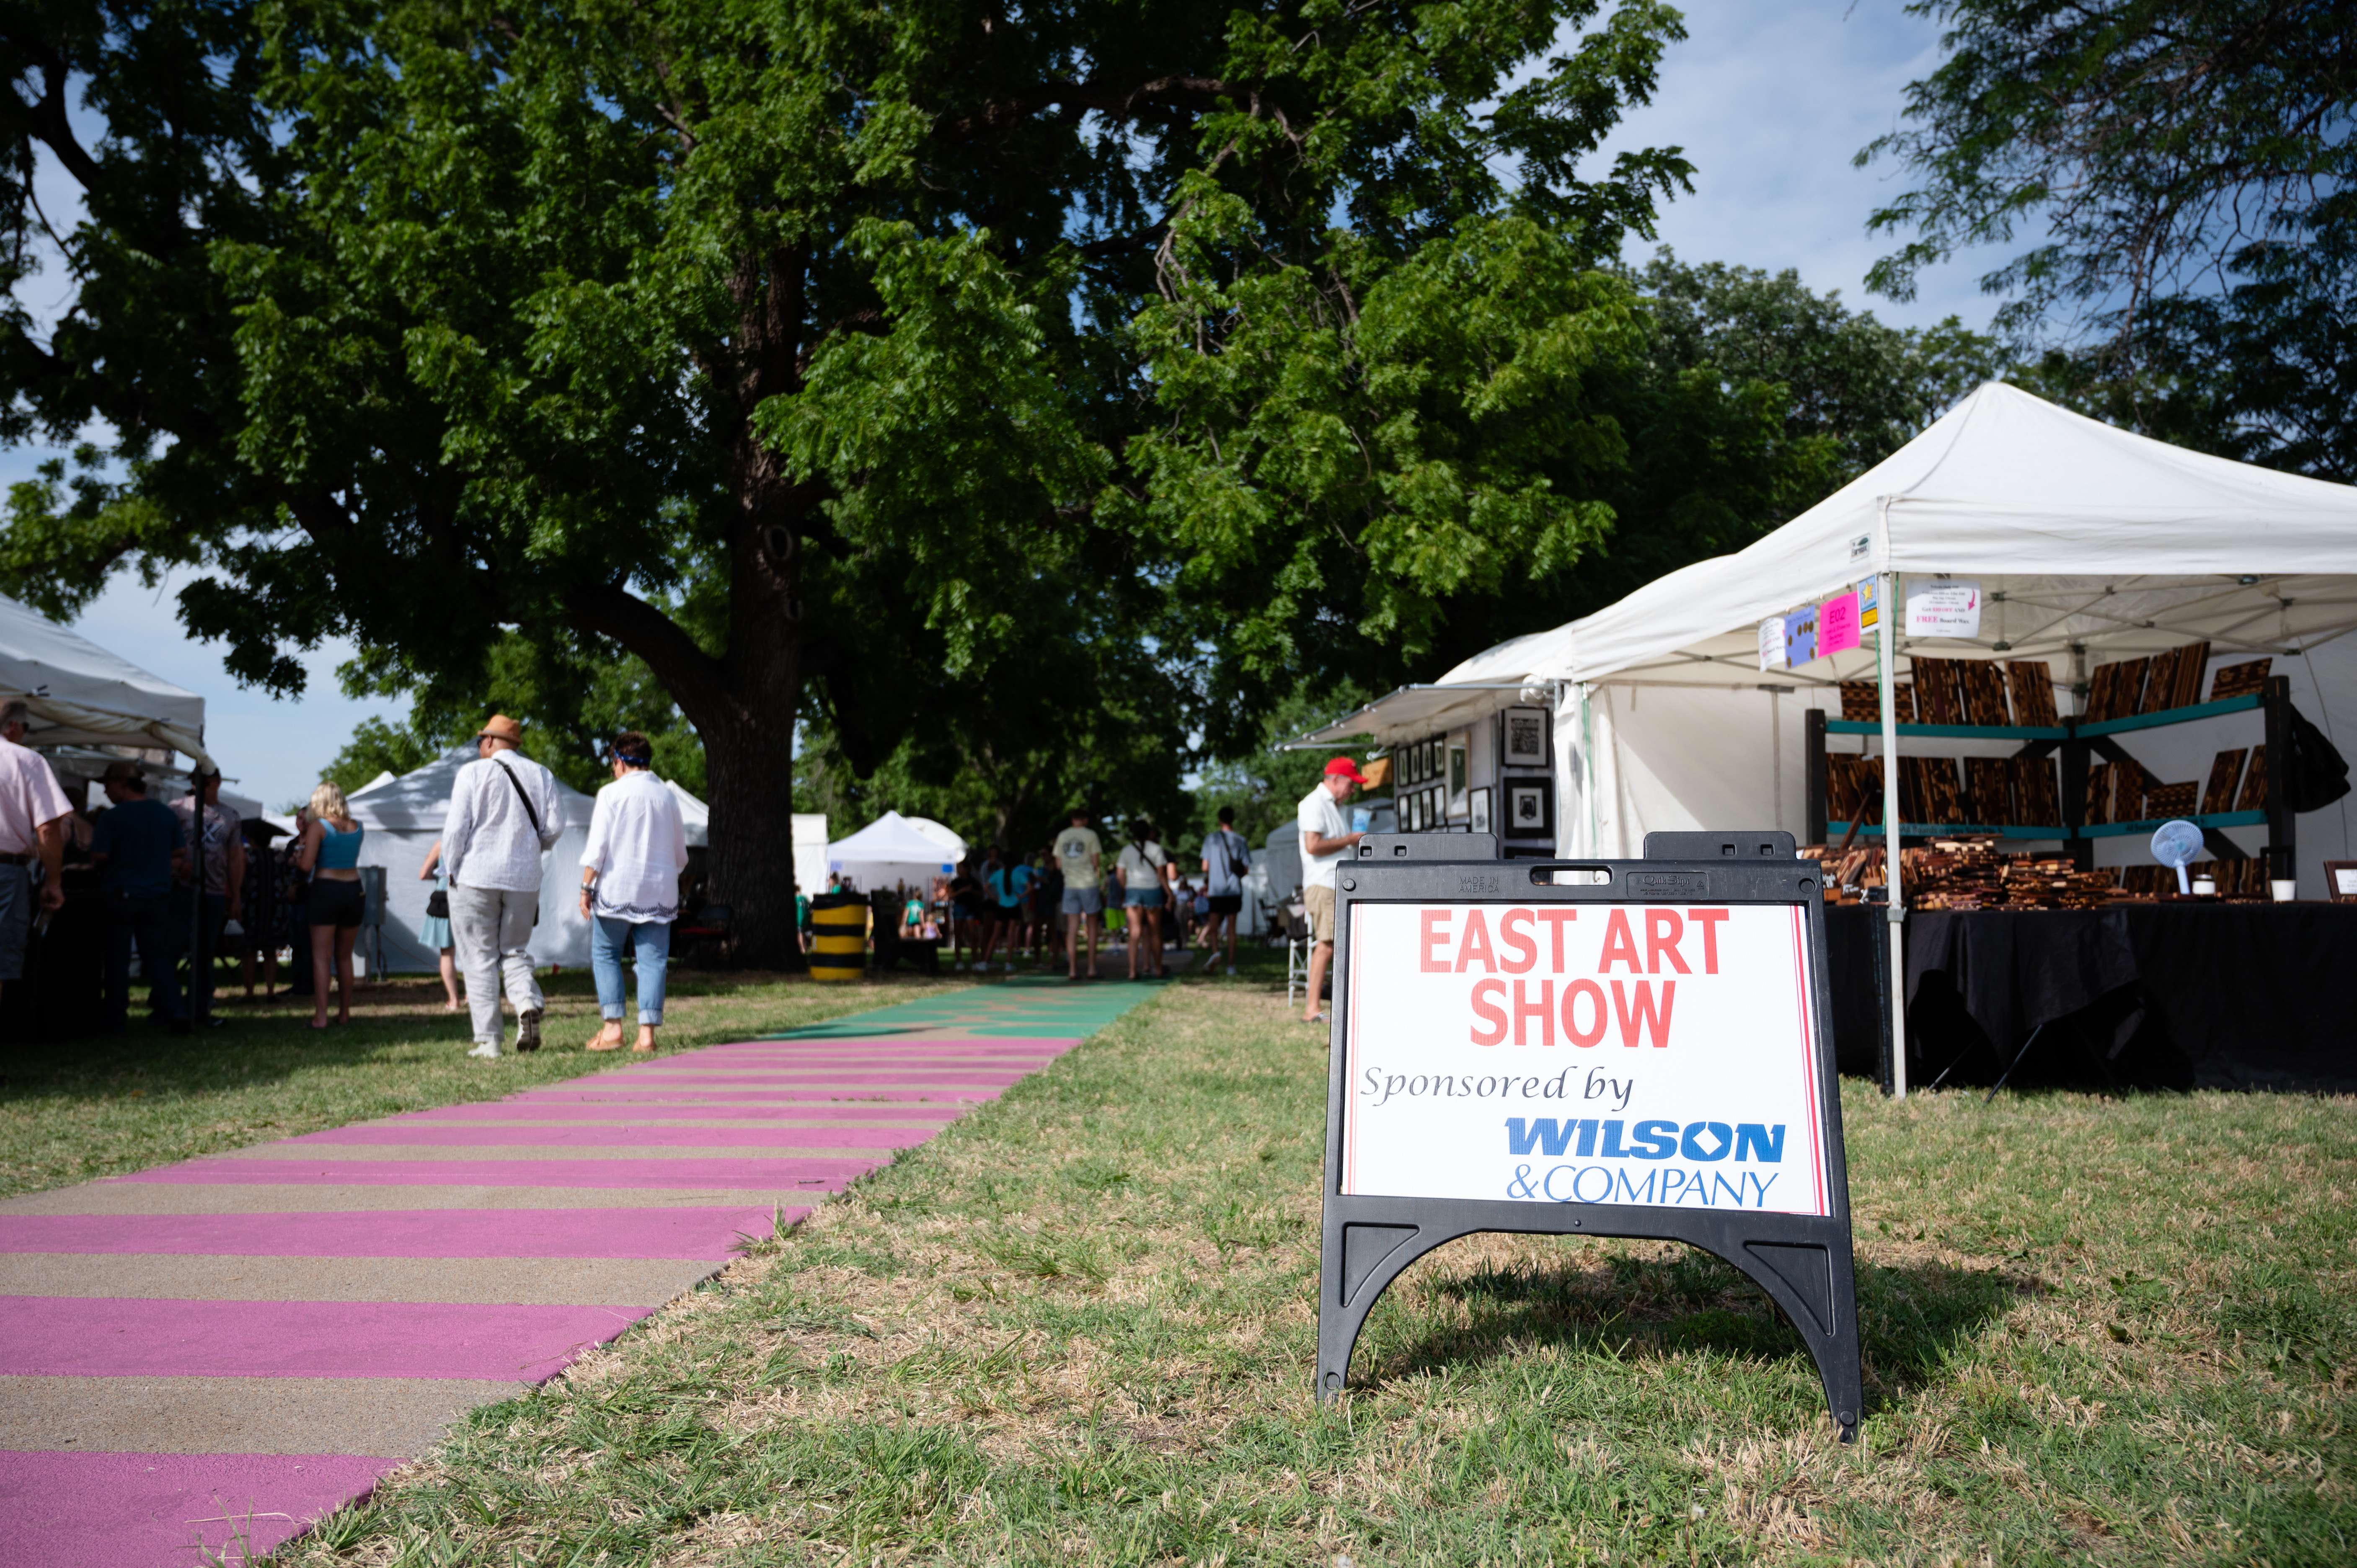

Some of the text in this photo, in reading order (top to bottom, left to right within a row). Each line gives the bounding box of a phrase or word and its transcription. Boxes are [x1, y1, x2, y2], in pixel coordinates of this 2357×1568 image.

[1829, 607, 1846, 624] E02
[1916, 615, 1938, 624] FREE
[1459, 876, 1499, 884] MADE IN
[1420, 909, 1729, 974] EAST ART
[1470, 978, 1676, 1048] SHOW
[1360, 1065, 1633, 1111] Sponsored by
[1505, 1118, 1786, 1162] WILSON
